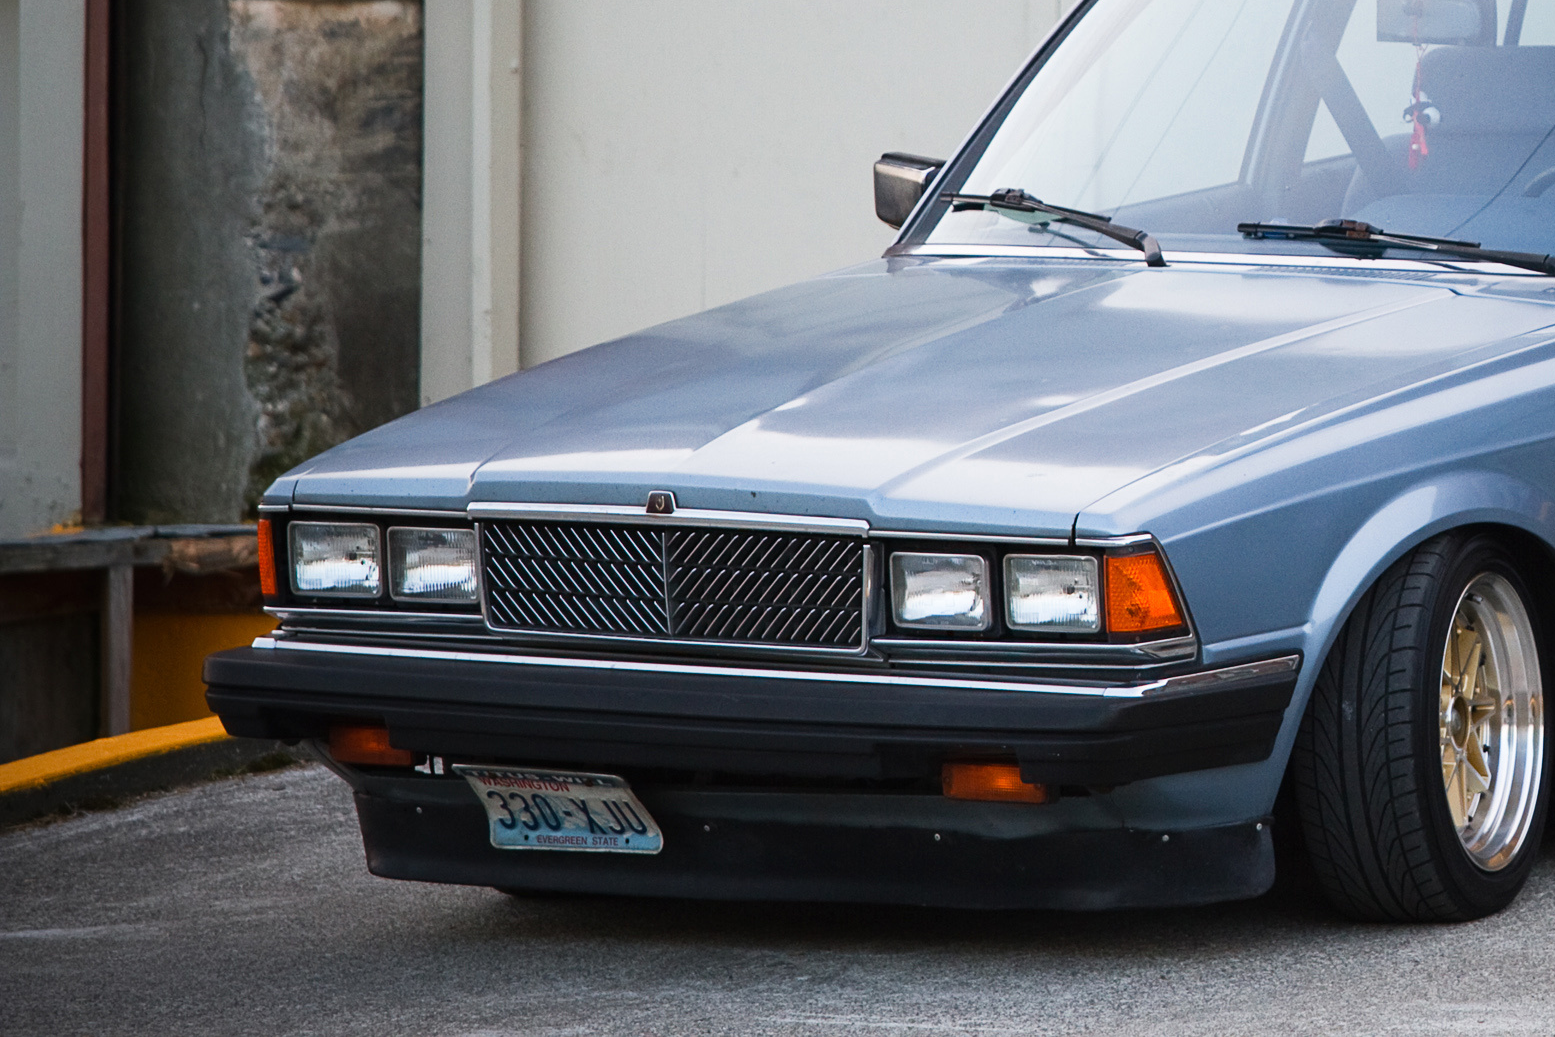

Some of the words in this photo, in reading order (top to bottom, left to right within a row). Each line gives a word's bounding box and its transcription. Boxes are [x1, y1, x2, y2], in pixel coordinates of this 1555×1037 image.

[480, 777, 570, 792] WASHINGTON
[487, 790, 648, 835] 330-XJU
[536, 835, 588, 846] EVERGREEN
[592, 836, 619, 847] STATE
